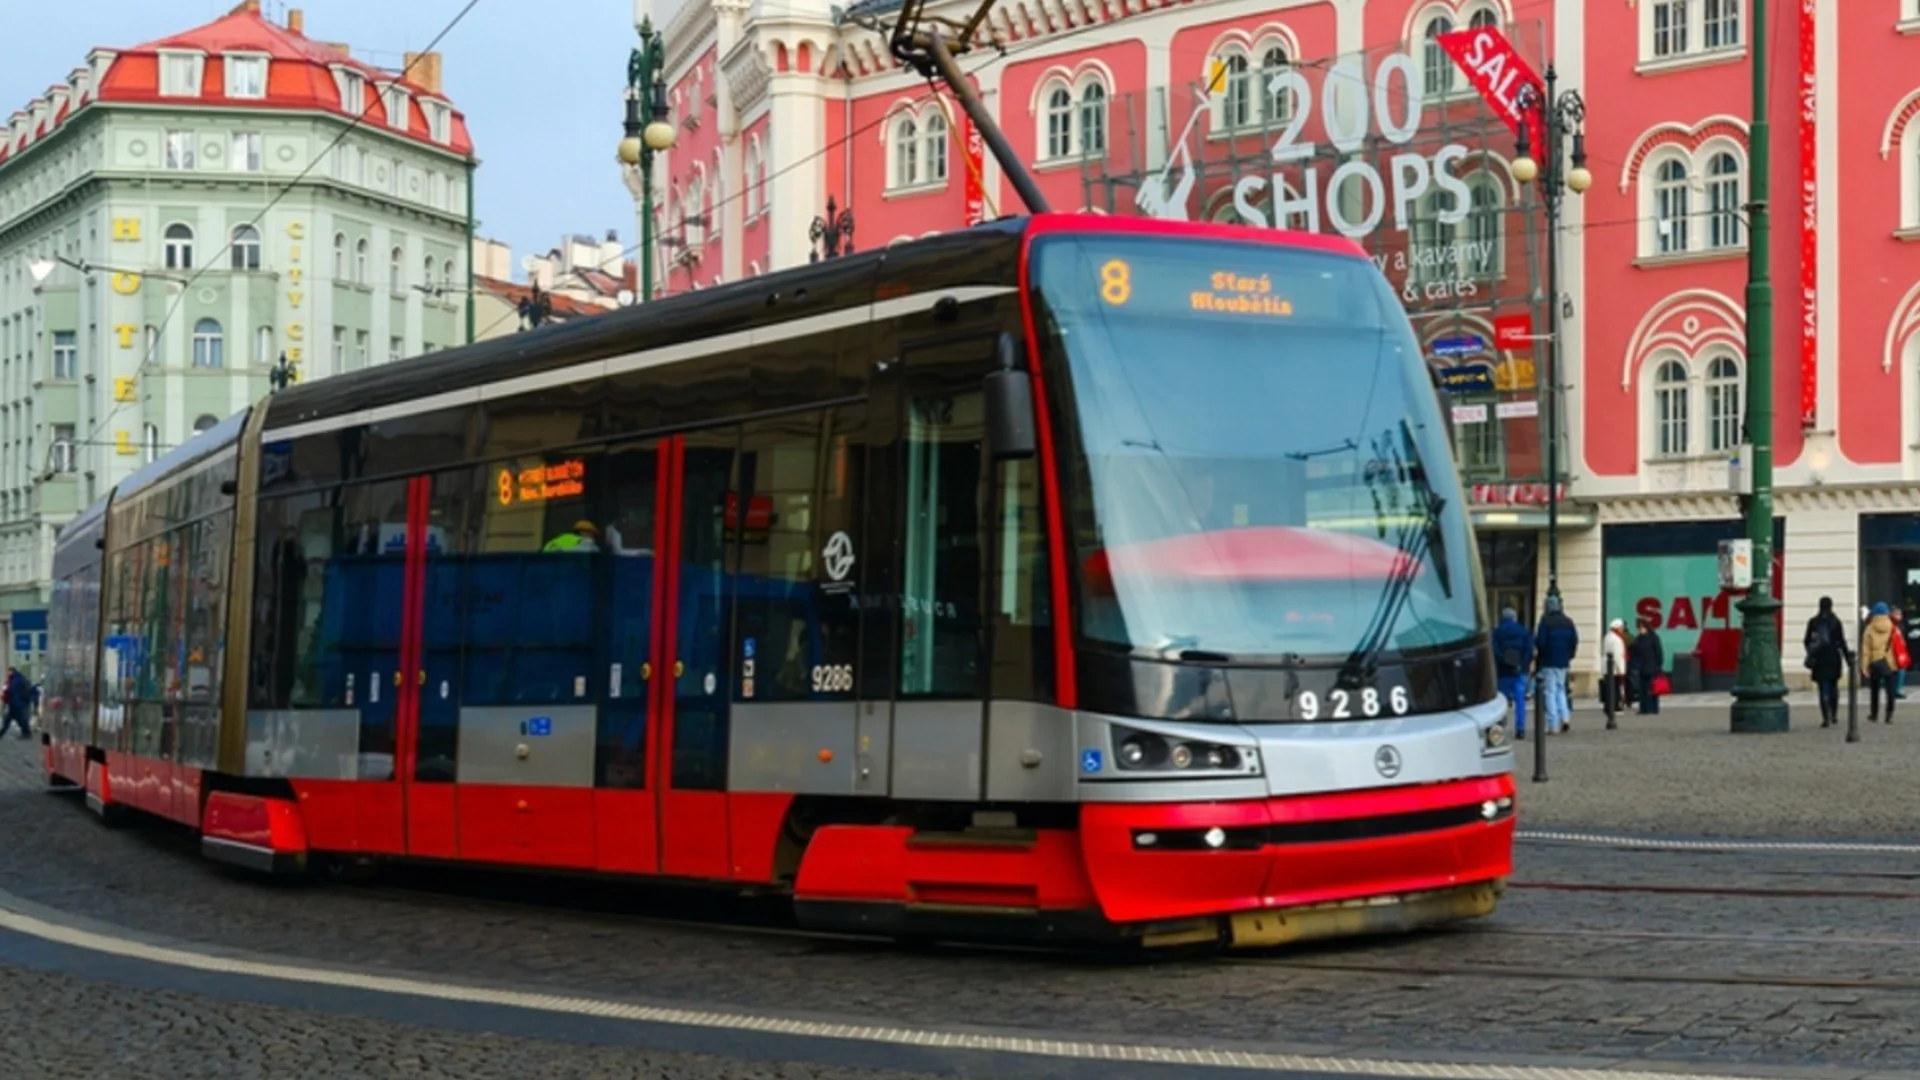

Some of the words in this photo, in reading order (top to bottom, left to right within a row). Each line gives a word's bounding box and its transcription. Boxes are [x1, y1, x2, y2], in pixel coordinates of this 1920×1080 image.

[1268, 53, 1423, 161] 200
[1803, 73, 1816, 122] SALE
[1234, 144, 1472, 237] SHOPS
[1803, 180, 1816, 229] SALE
[286, 222, 305, 308] CITY
[1101, 259, 1130, 305] 8
[1394, 251, 1407, 271] a
[1402, 279, 1419, 302] &
[1425, 271, 1478, 300] cafés
[111, 218, 141, 455] HOTEL
[1803, 288, 1816, 337] SALE
[498, 468, 512, 506] 8
[812, 664, 853, 692] 9286
[1299, 685, 1408, 721] 9286
